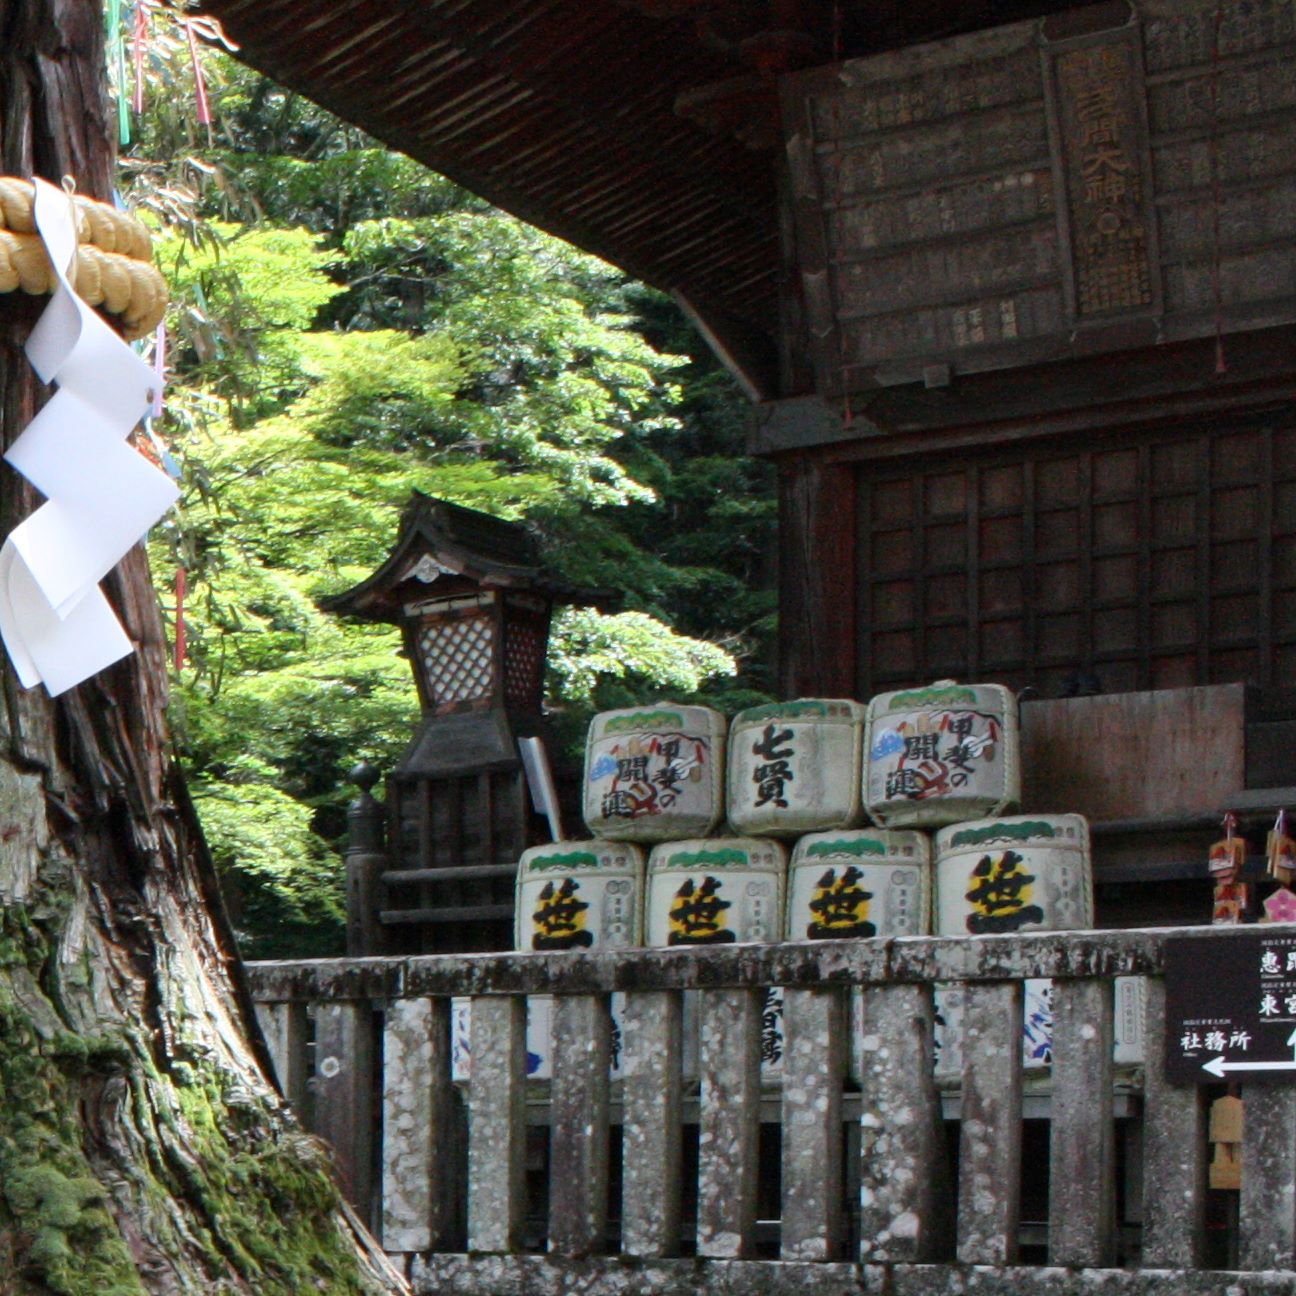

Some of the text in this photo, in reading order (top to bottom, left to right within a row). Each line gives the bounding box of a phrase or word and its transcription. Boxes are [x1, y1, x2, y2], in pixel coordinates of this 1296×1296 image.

[652, 738, 684, 808] 甲斐の
[752, 723, 795, 809] 七賢
[886, 732, 940, 800] 開運
[942, 715, 976, 788] 甲斐の
[601, 755, 650, 819] 開運
[1180, 1030, 1252, 1052] 社務所
